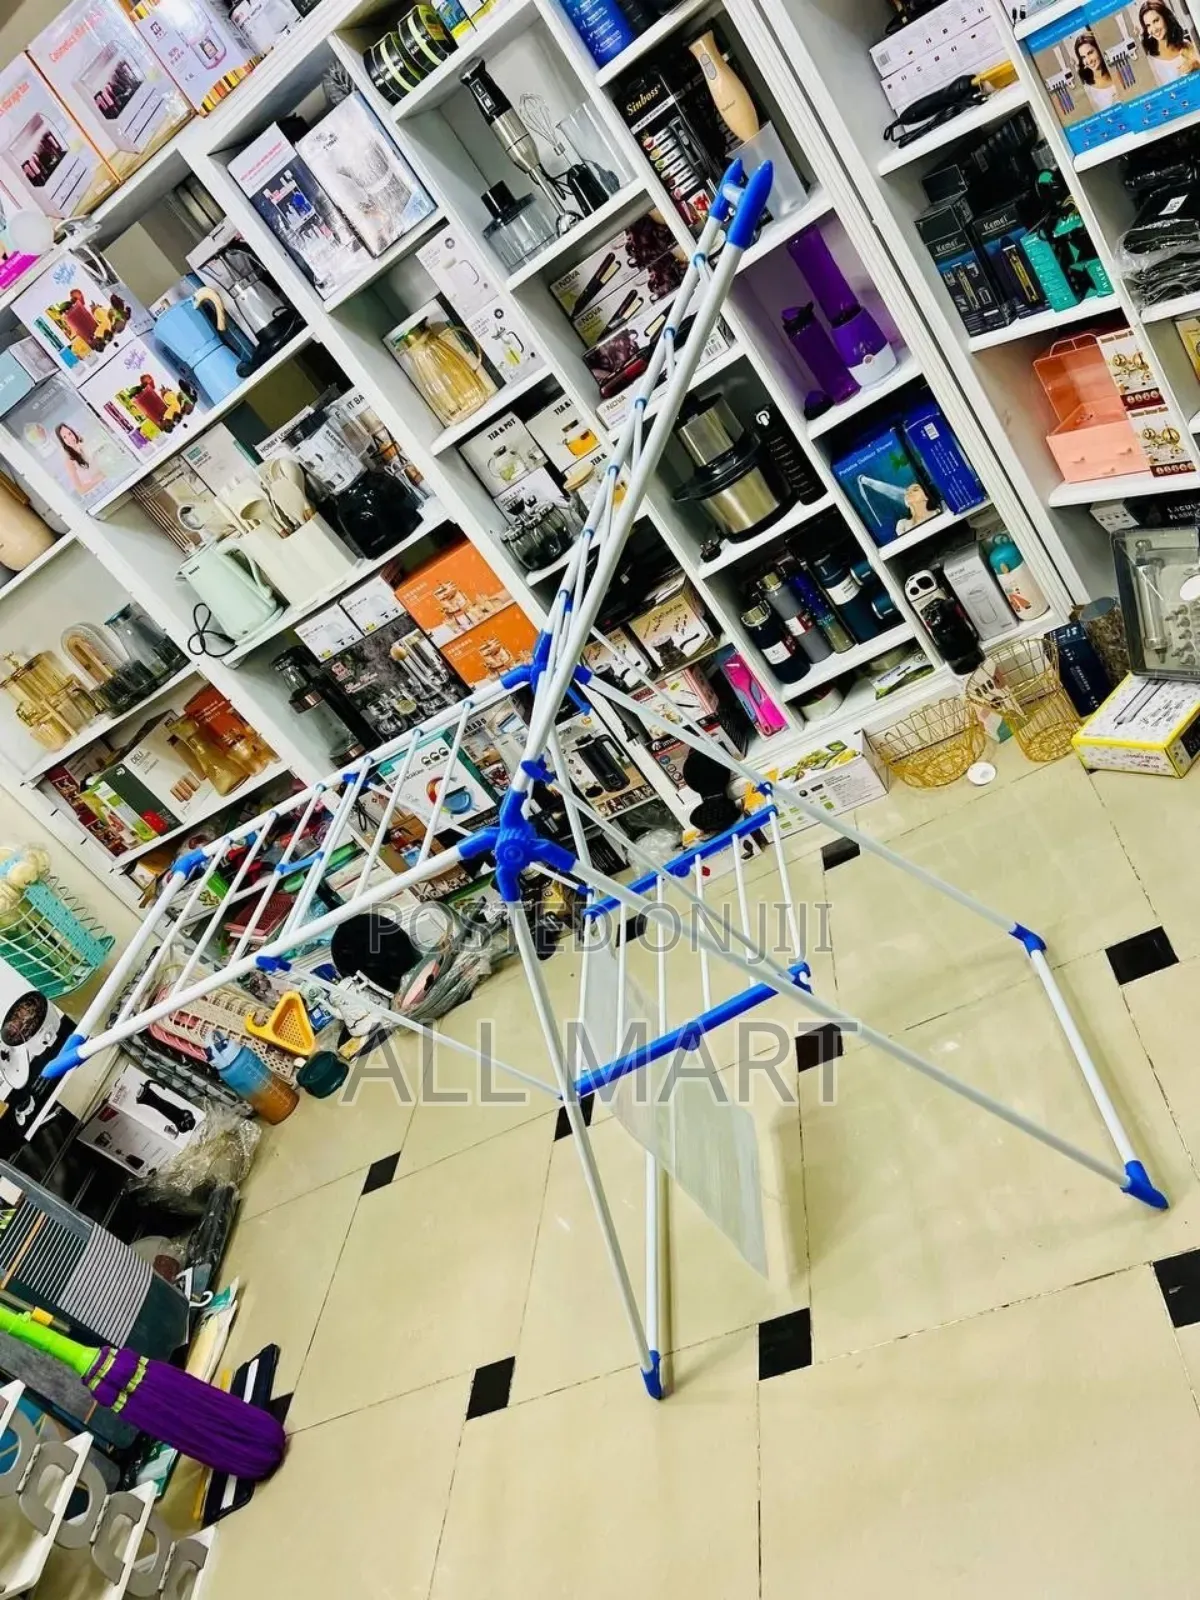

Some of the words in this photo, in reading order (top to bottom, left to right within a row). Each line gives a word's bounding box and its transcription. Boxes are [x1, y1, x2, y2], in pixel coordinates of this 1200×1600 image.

[624, 84, 659, 115] Sinboss
[557, 269, 580, 288] NOVA
[580, 305, 602, 324] NOVA
[605, 394, 626, 411] NOVA
[486, 429, 500, 441] TEA
[502, 417, 516, 429] POT
[1167, 501, 1200, 513] VACUU
